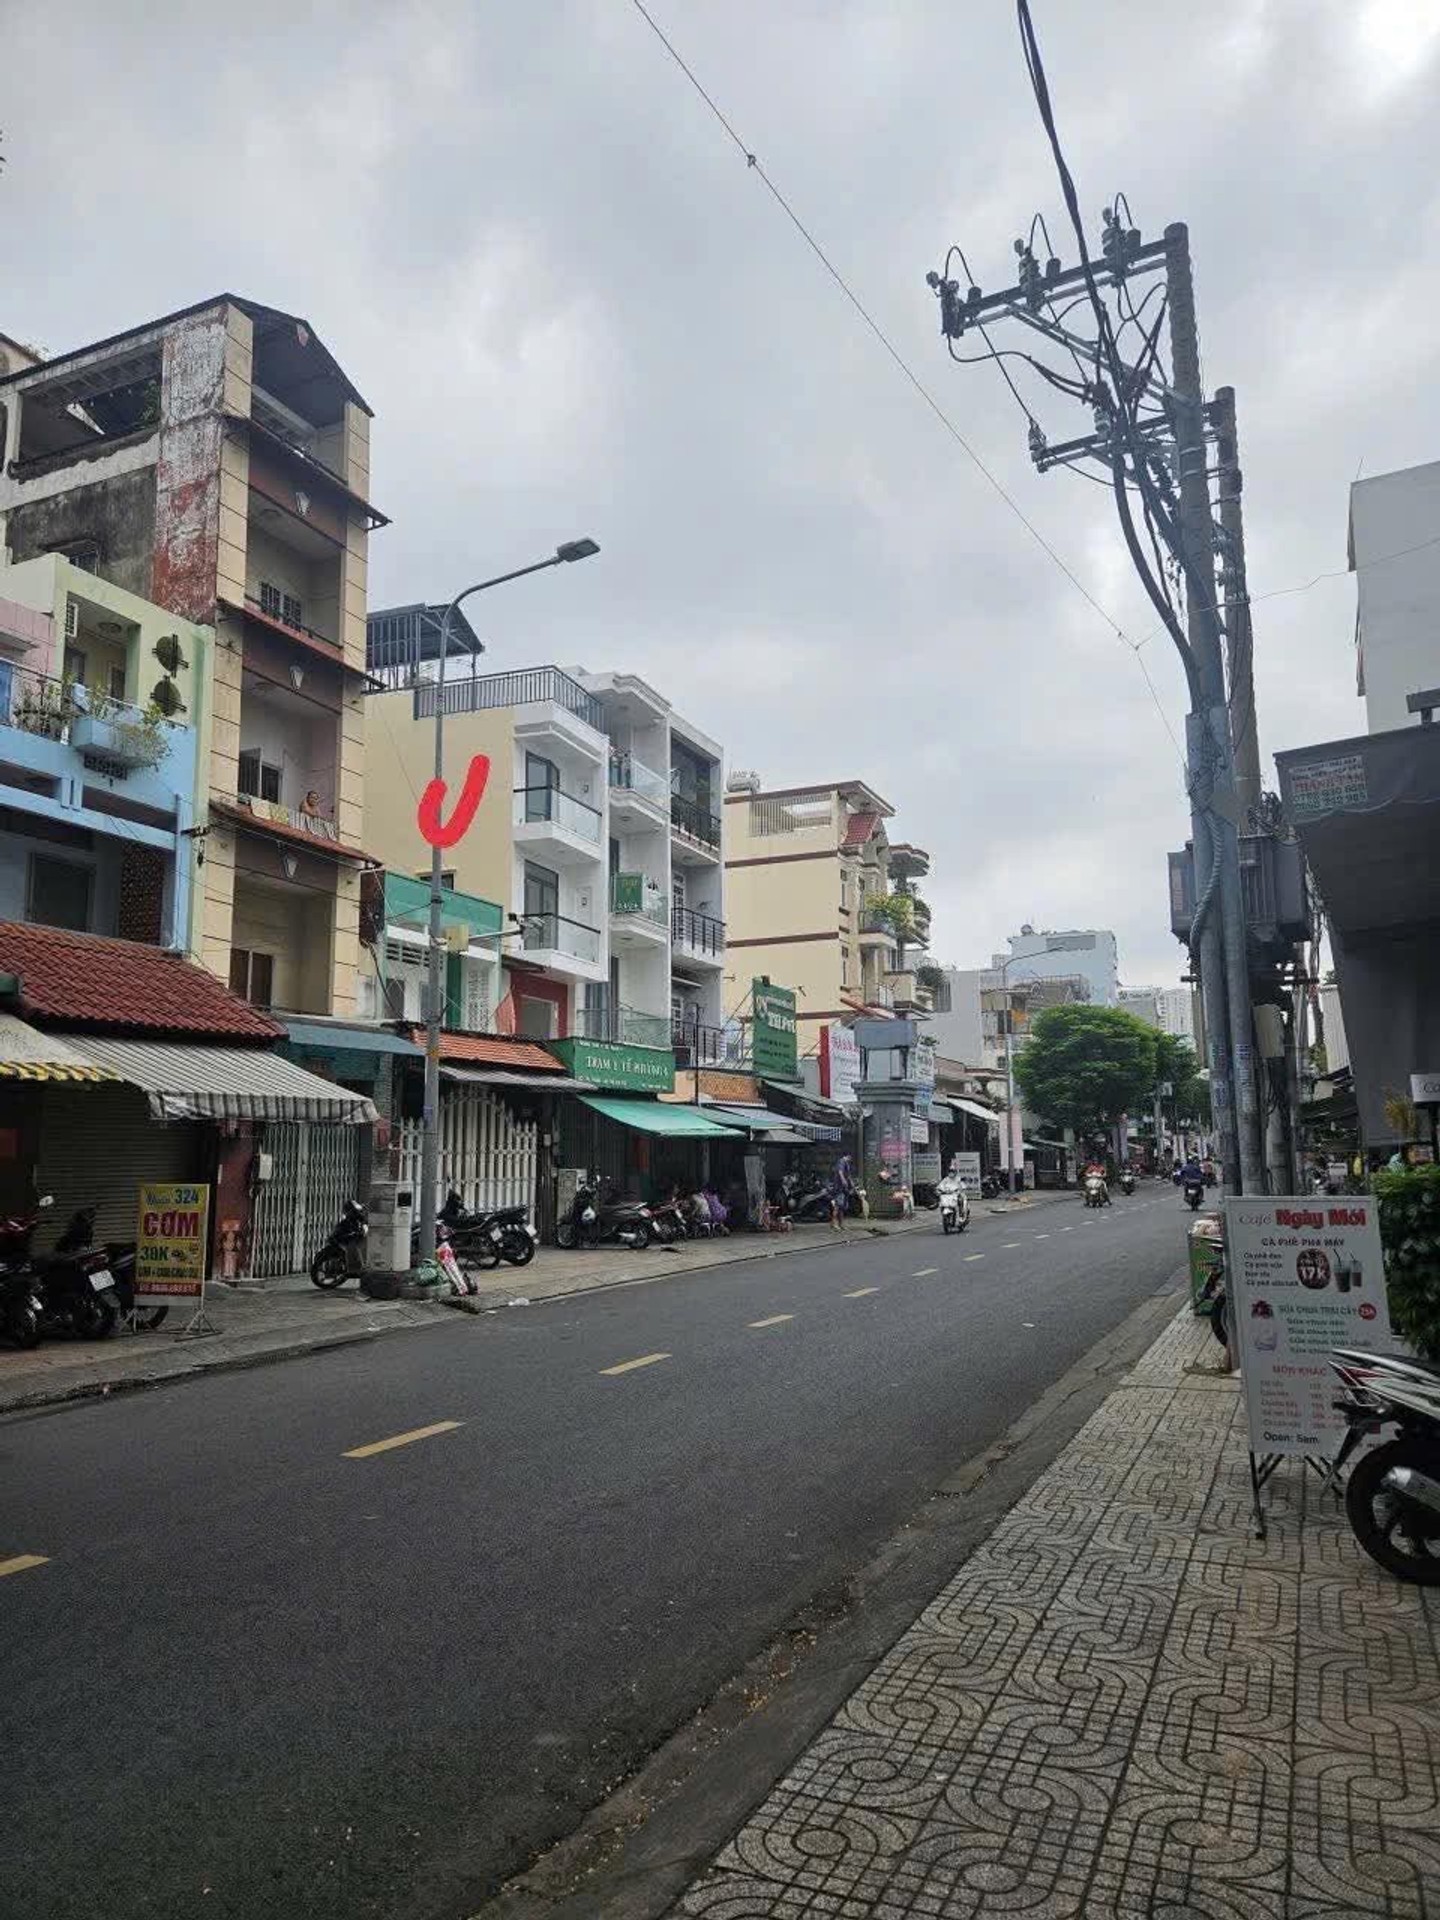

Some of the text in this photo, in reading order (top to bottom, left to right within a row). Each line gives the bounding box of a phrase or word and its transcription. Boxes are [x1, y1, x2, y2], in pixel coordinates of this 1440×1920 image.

[174, 1189, 198, 1204] 324
[144, 1209, 199, 1237] CƠM
[1275, 1209, 1324, 1230] Ngày
[1328, 1208, 1366, 1226] Mới
[1263, 1431, 1294, 1442] Open:
